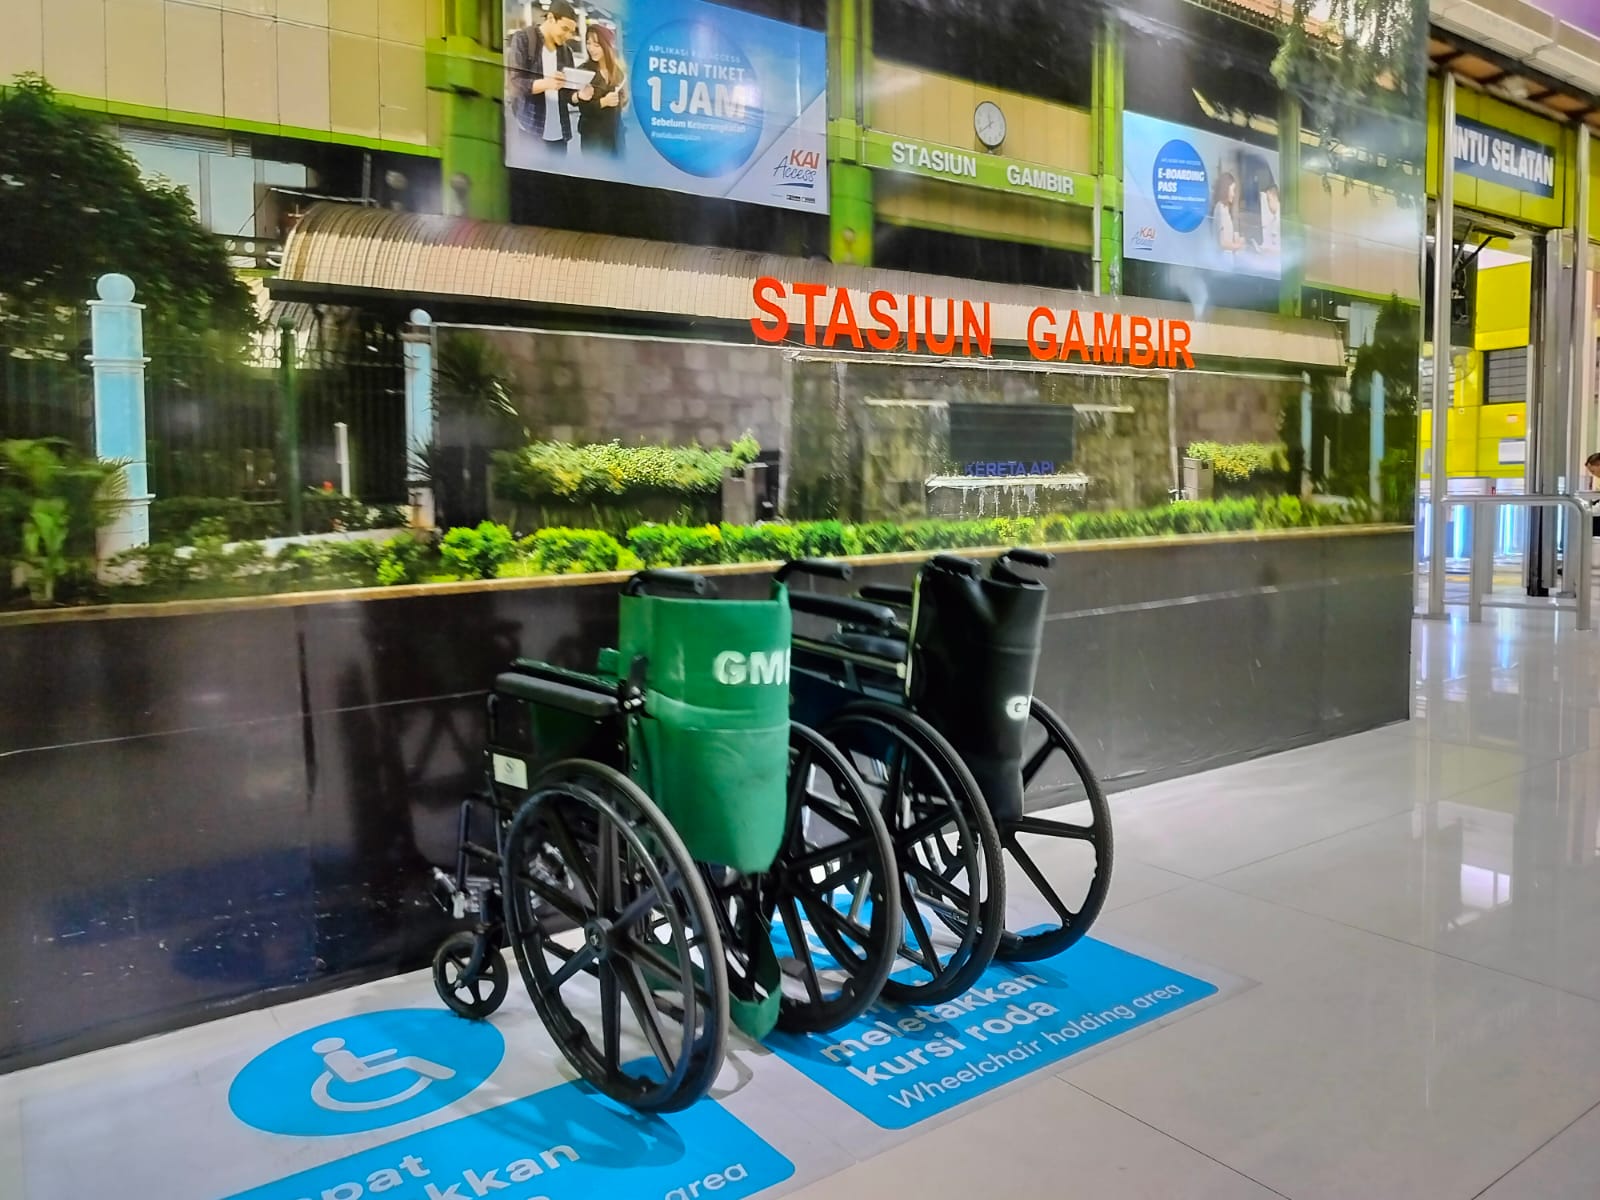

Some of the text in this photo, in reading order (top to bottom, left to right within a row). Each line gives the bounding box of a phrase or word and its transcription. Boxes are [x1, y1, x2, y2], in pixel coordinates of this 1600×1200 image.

[648, 45, 688, 57] APLIKASI
[649, 57, 745, 82] PESAN TIKET
[647, 76, 746, 118] 1 JAM
[651, 117, 686, 128] Sebelum
[773, 155, 816, 182] Access
[790, 149, 820, 169] KAI
[892, 141, 1074, 195] STASIUN GAMBIR
[1492, 138, 1554, 187] SELATAN
[1158, 181, 1177, 193] PASS
[751, 275, 1195, 368] STASIUN GAMBIR
[964, 460, 1054, 476] KERETA API
[819, 974, 1048, 1063] meletakkan
[846, 1031, 966, 1086] kursi
[965, 1001, 1060, 1042] roda
[888, 984, 1185, 1109] Wheelchair holding area
[297, 1154, 431, 1200] pat
[664, 1163, 749, 1200] area
